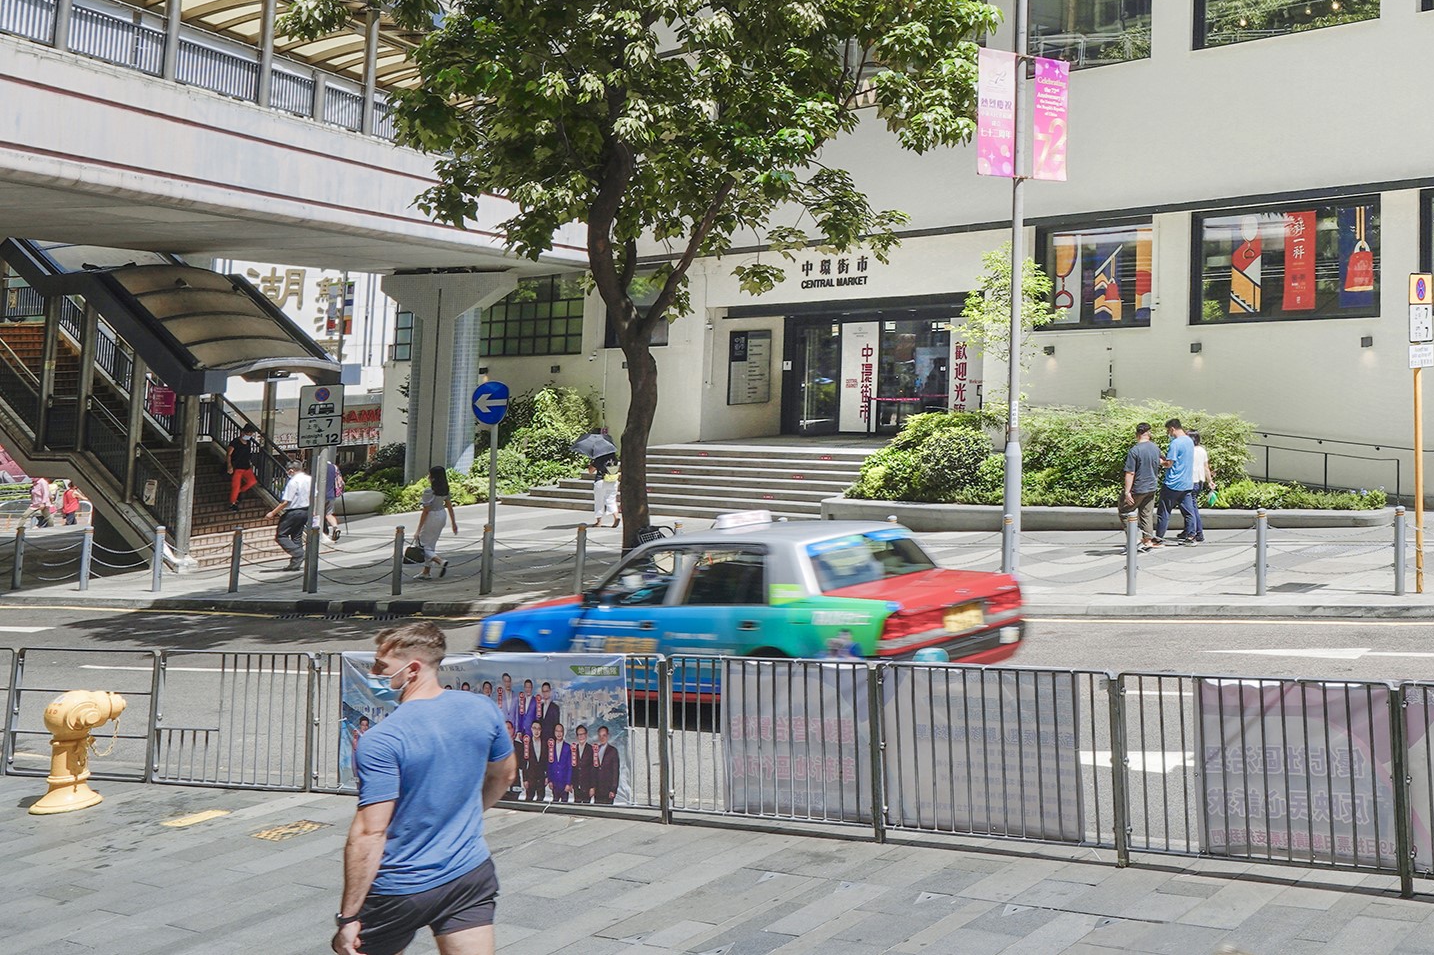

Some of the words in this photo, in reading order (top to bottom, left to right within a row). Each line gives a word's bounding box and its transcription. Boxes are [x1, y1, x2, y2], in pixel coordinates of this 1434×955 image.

[801, 255, 869, 277] 中環街市
[801, 278, 835, 290] CENTRAL
[836, 276, 868, 287] MARKET
[859, 343, 873, 423] 中環街市
[326, 418, 333, 428] 7
[326, 433, 339, 443] 12
